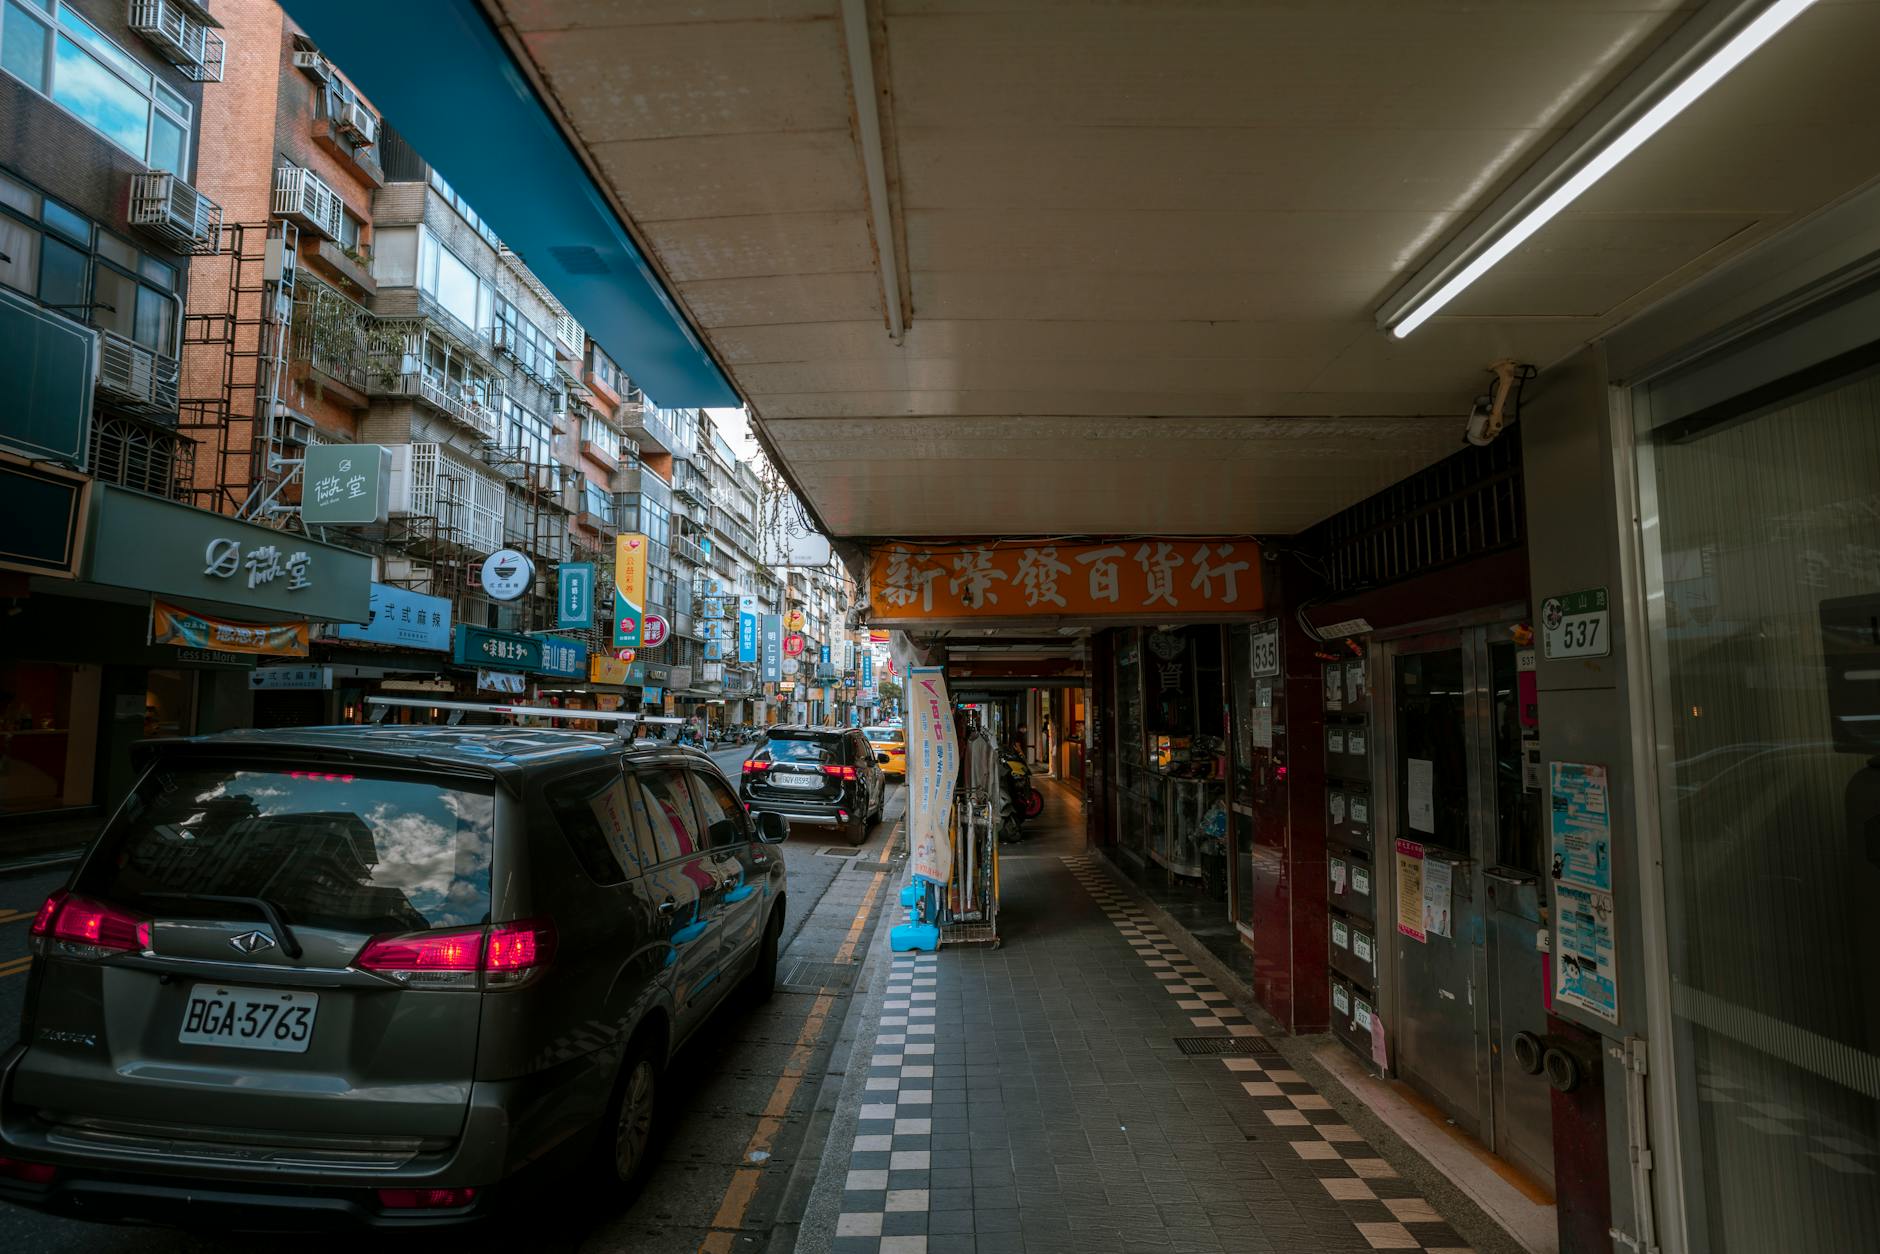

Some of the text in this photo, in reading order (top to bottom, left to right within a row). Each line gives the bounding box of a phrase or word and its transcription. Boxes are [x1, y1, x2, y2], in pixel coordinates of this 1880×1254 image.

[881, 542, 1250, 612] 新榮發百貨行
[1564, 618, 1600, 649] 537
[1255, 642, 1275, 669] 535
[1156, 662, 1185, 695] 資
